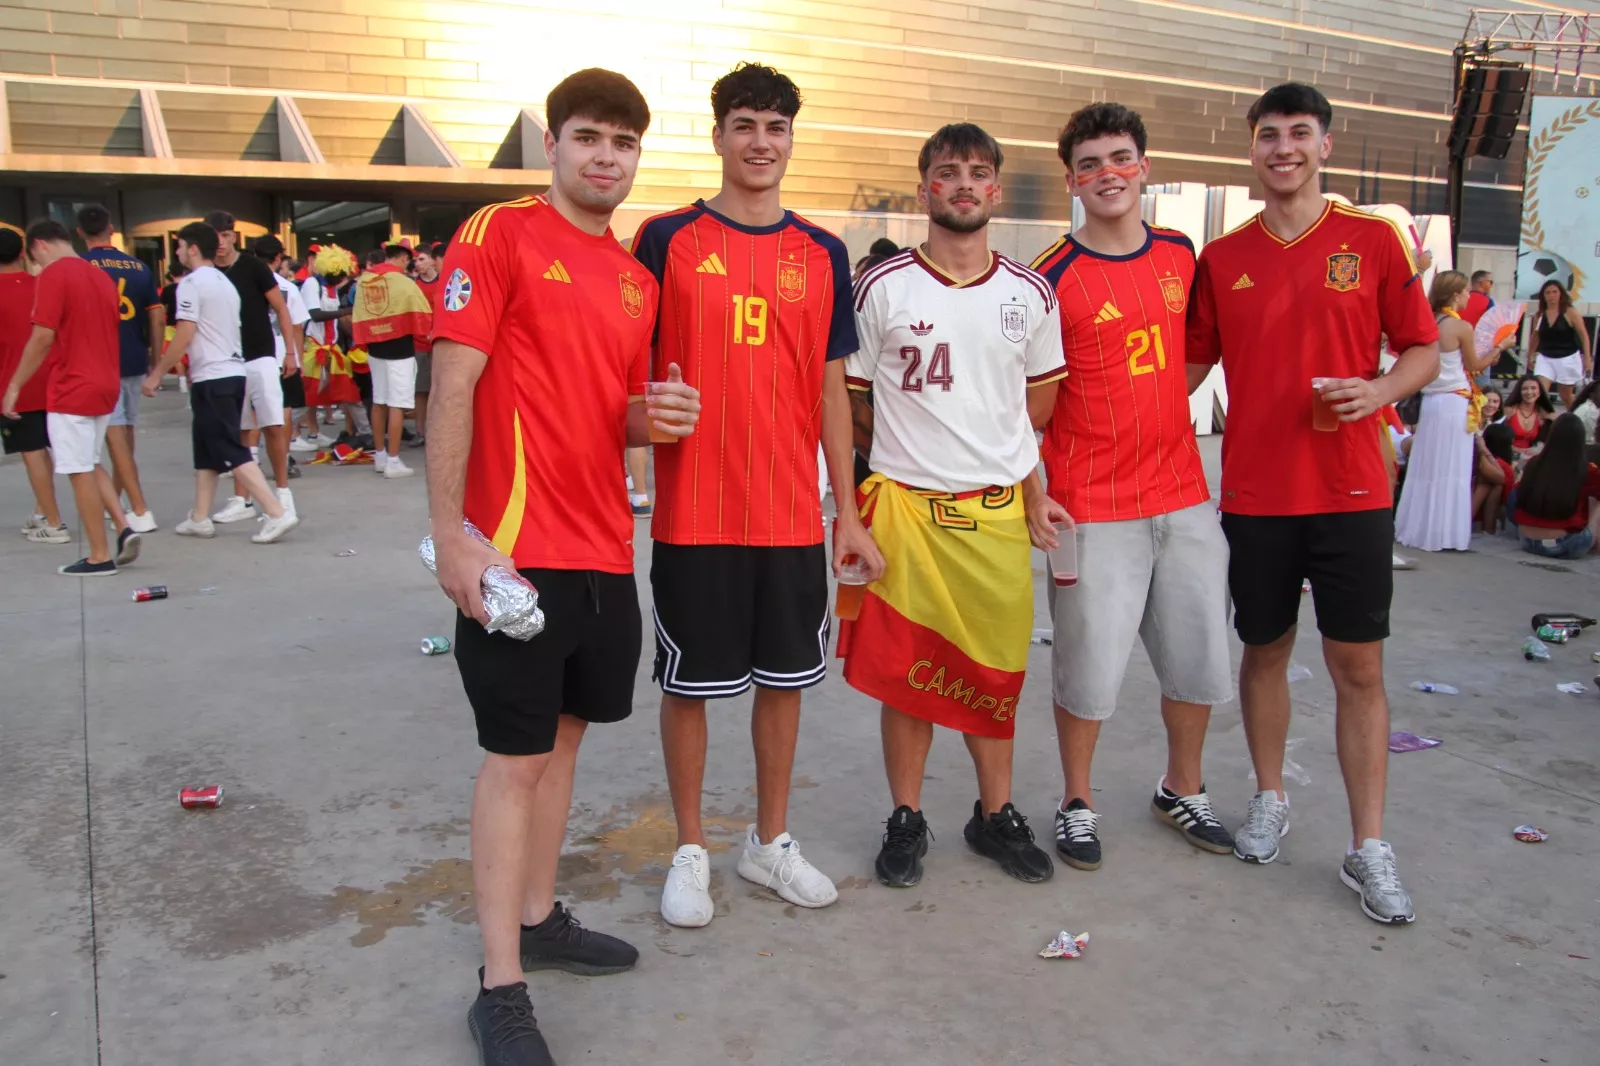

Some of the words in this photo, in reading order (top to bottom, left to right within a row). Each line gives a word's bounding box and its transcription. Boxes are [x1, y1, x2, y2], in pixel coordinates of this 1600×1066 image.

[118, 277, 136, 320] 6
[732, 295, 767, 345] 19
[900, 343, 954, 393] 24
[1126, 324, 1165, 376] 21
